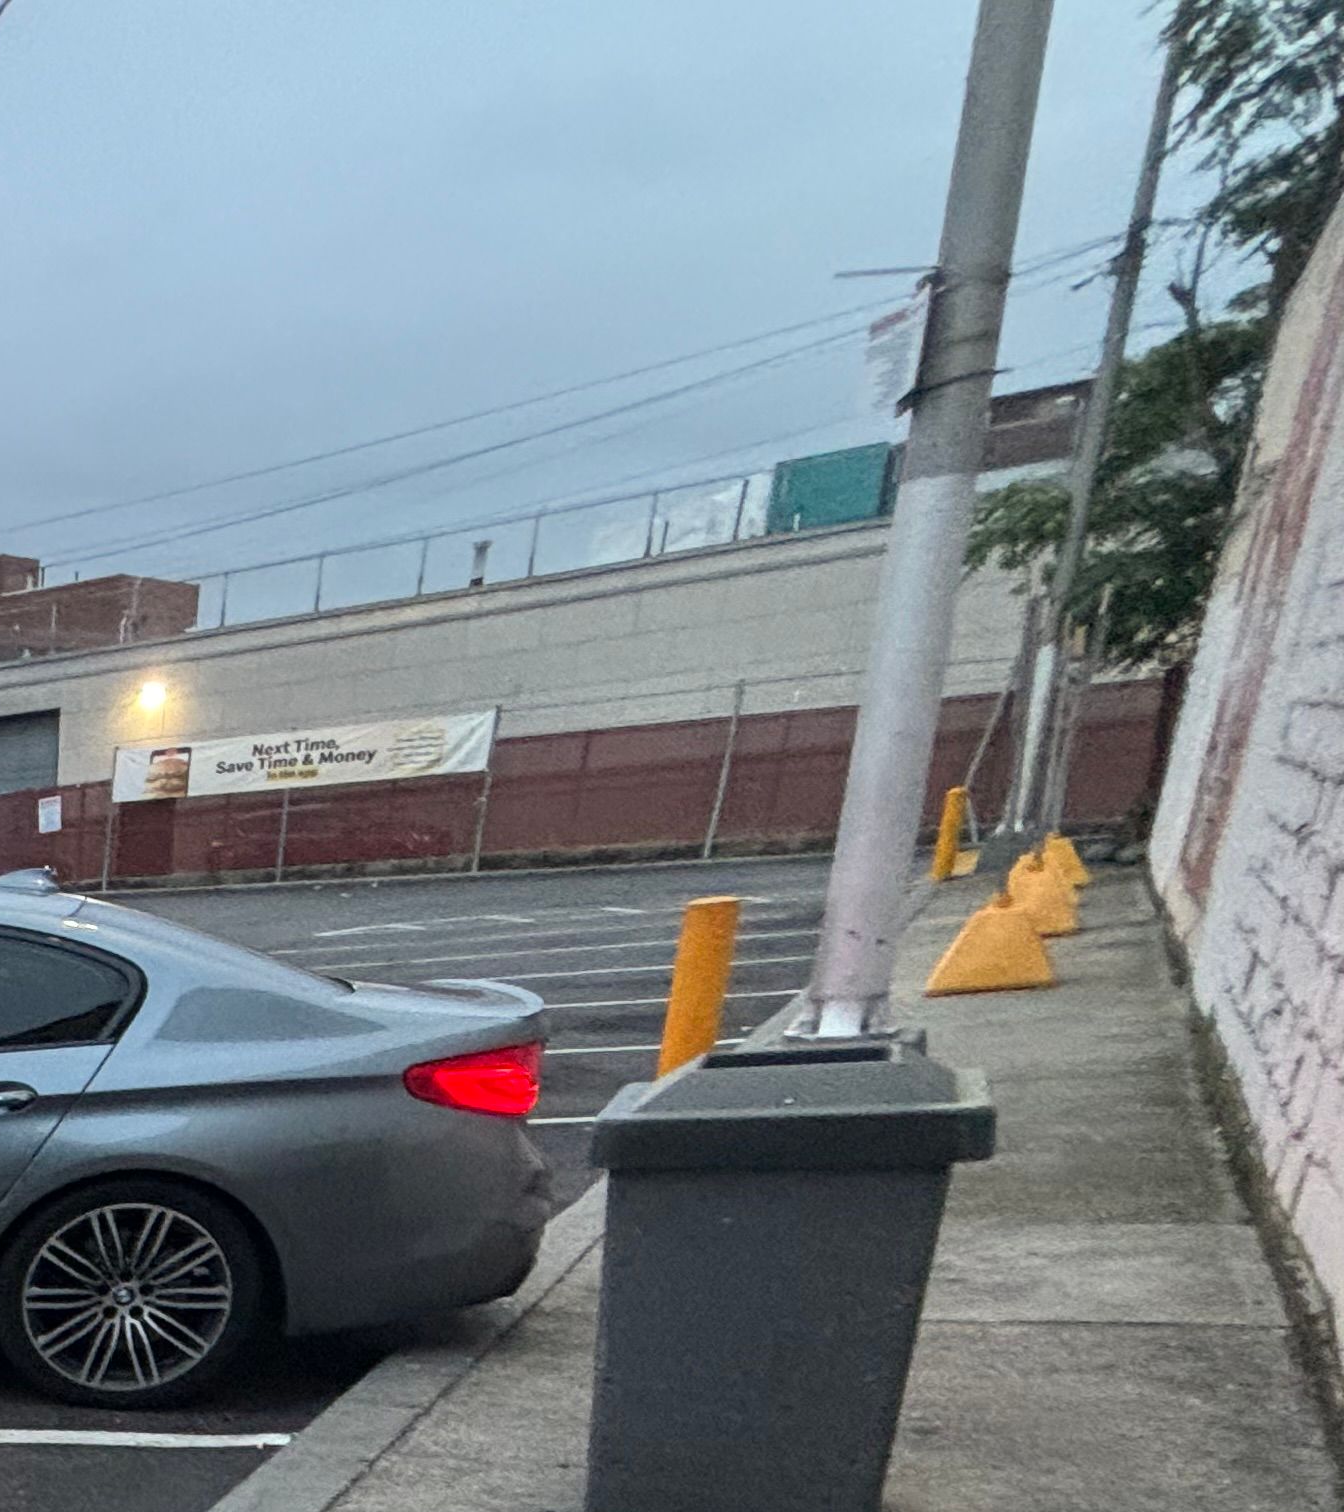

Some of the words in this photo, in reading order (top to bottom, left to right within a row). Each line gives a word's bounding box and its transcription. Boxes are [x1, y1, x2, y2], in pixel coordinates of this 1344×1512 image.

[252, 741, 290, 757] Next
[294, 737, 340, 753] Time,
[216, 760, 254, 774] Save
[257, 755, 298, 770] Time
[301, 753, 314, 766] &
[317, 749, 377, 765] Money
